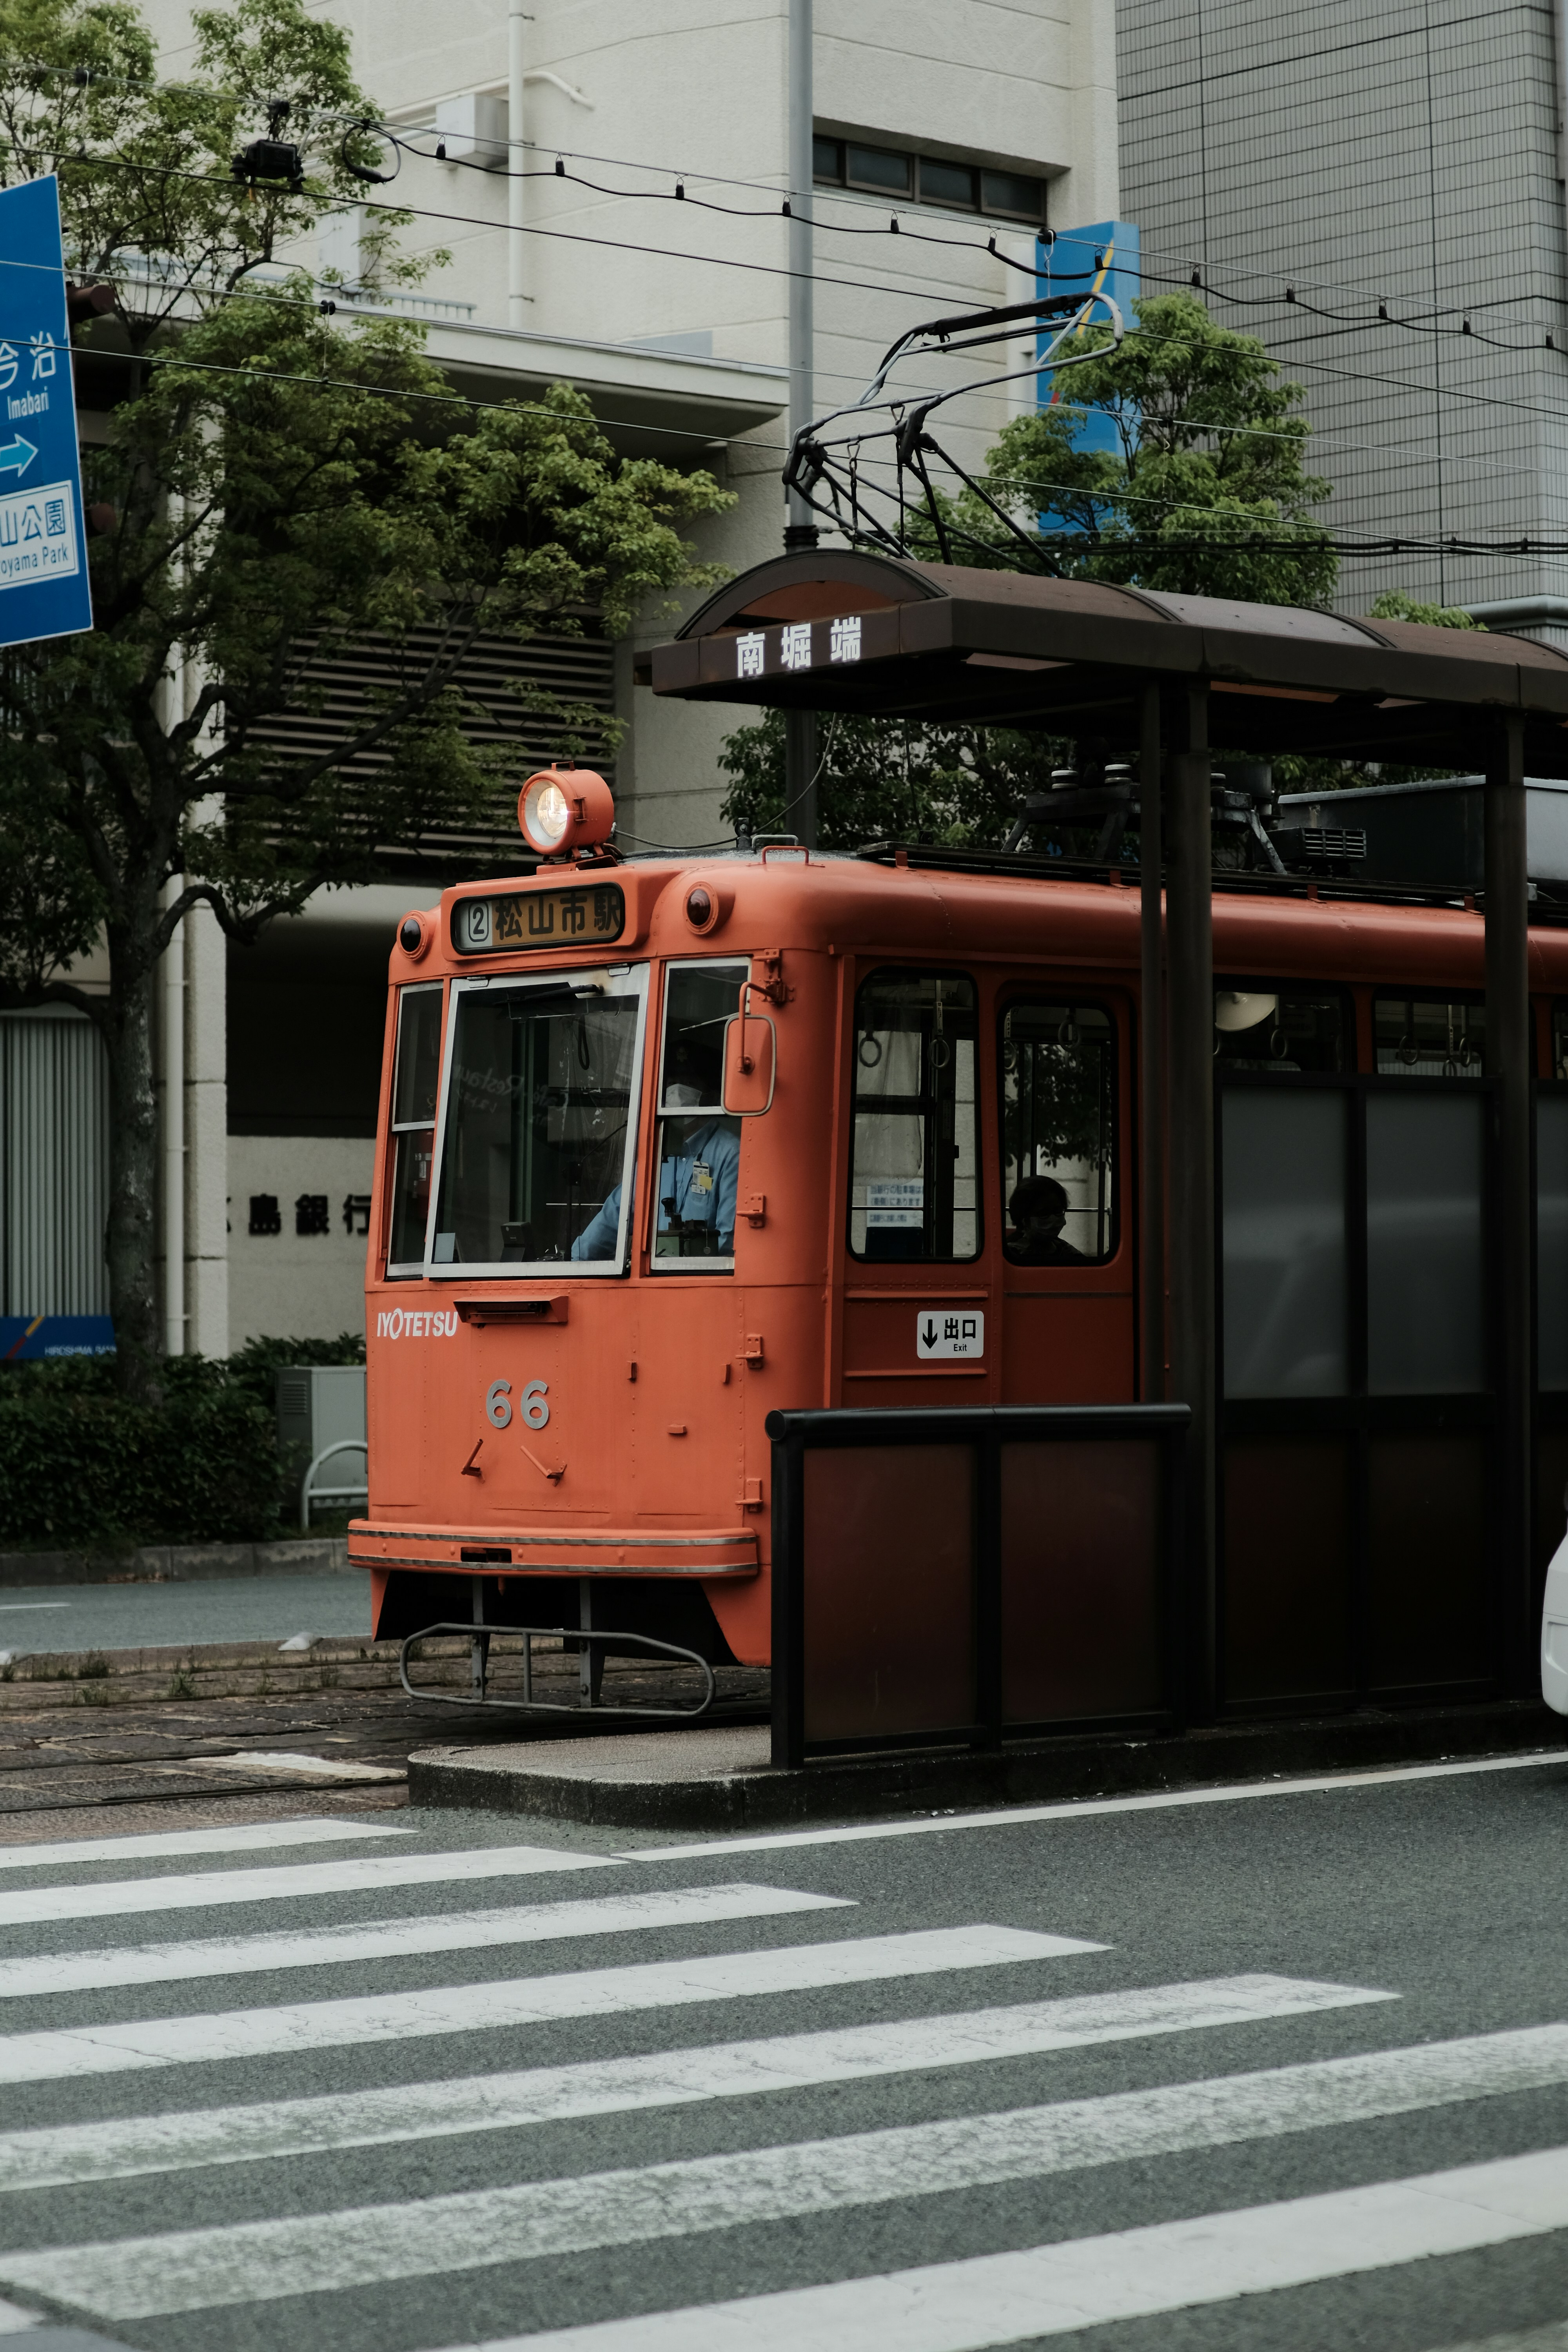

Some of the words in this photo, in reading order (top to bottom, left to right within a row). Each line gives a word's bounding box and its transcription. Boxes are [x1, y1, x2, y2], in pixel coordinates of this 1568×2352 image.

[7, 386, 49, 420] Imabari
[0, 499, 65, 546] 山公園
[43, 543, 68, 566] Park
[736, 616, 861, 677] 南堀端
[495, 892, 620, 941] 松山市駅
[226, 1193, 372, 1236] 島銀行
[377, 1308, 458, 1339] IYOTETSU
[944, 1318, 976, 1340] 出口
[953, 1343, 967, 1352] Exit
[486, 1379, 549, 1429] 66
